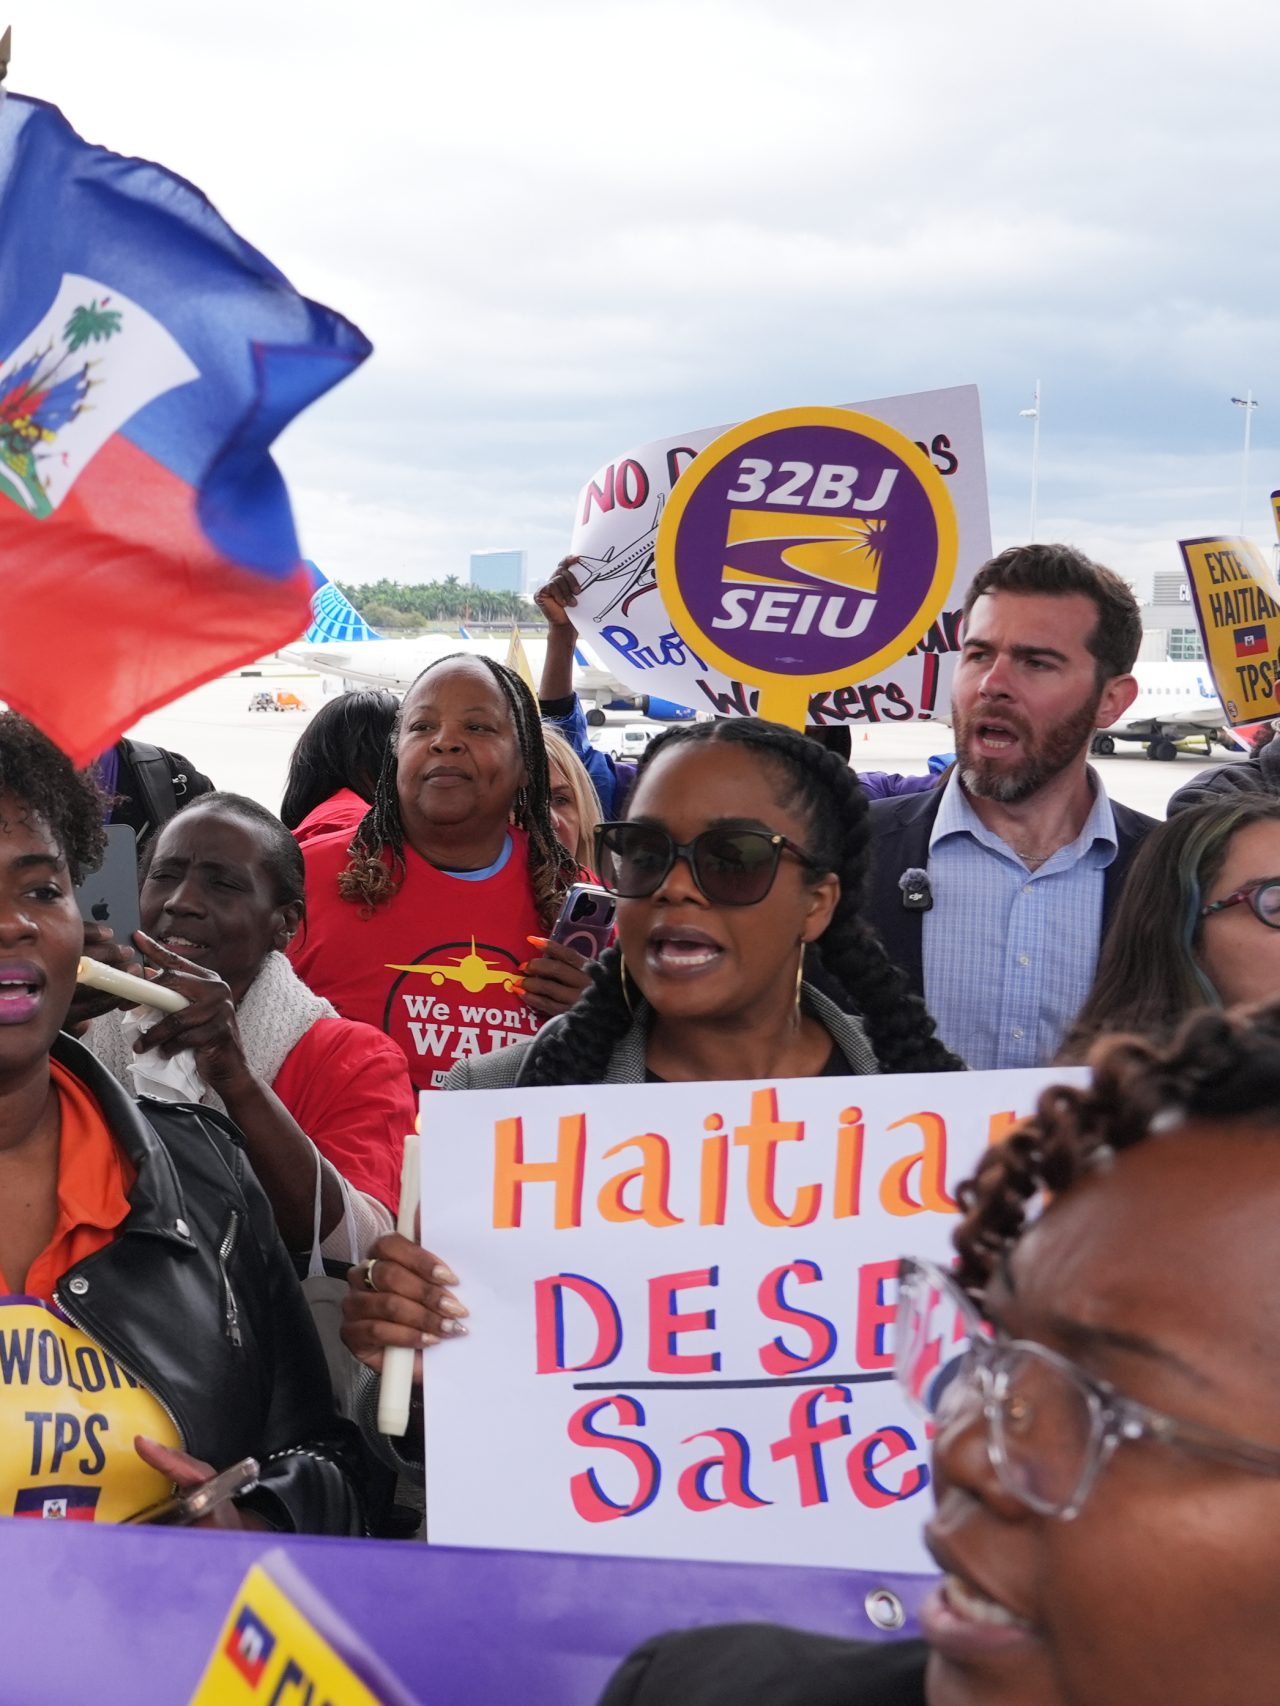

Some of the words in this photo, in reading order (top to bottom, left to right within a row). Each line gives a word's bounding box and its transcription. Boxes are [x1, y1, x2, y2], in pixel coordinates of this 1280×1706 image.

[582, 459, 650, 526] NO
[726, 458, 899, 512] 32BJ
[1204, 551, 1252, 585] EXTE
[712, 589, 878, 638] SEIU
[402, 994, 450, 1021] We
[458, 1005, 539, 1032] won't
[492, 1086, 1036, 1229] Haitia
[24, 1411, 109, 1476] TPS
[567, 1384, 933, 1523] Safe
